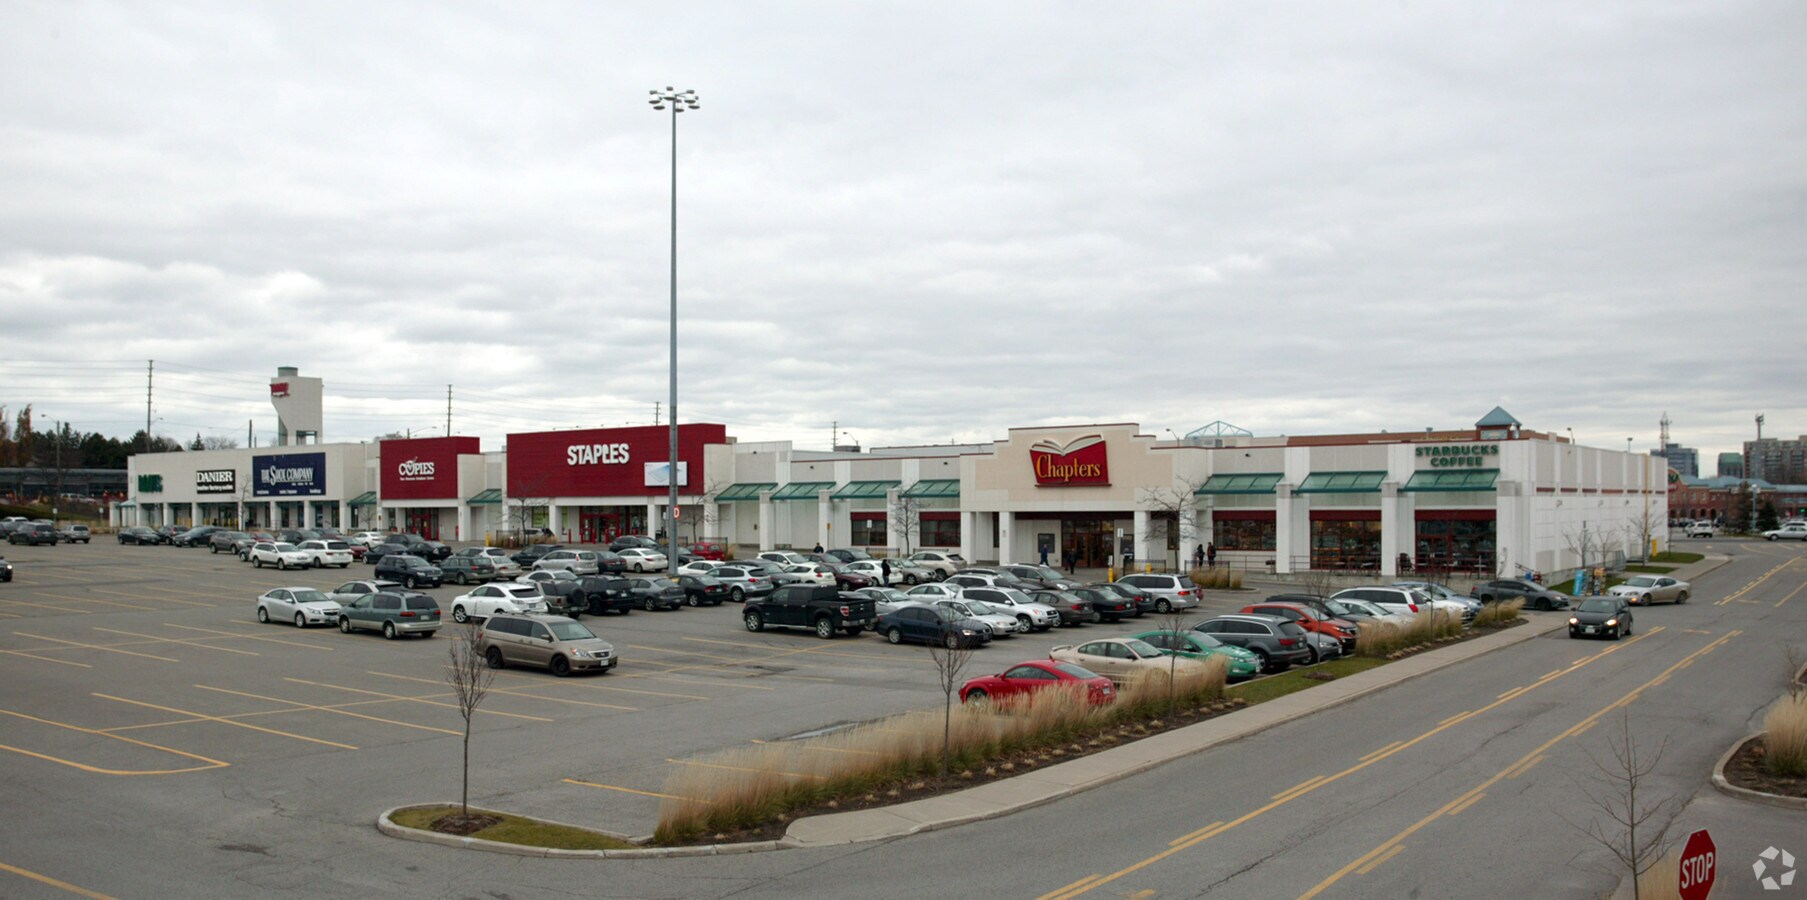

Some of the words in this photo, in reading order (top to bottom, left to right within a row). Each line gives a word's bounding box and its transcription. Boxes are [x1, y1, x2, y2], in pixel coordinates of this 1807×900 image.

[567, 443, 630, 465] STAPLES
[1415, 444, 1499, 457] STARBUCKS
[398, 459, 435, 476] COPIES
[1036, 454, 1102, 482] Chapters
[1430, 456, 1483, 467] COFFEE
[197, 471, 234, 483] DANIER
[286, 467, 314, 483] COMPANY
[674, 508, 680, 518] D
[1681, 851, 1714, 889] STOP
